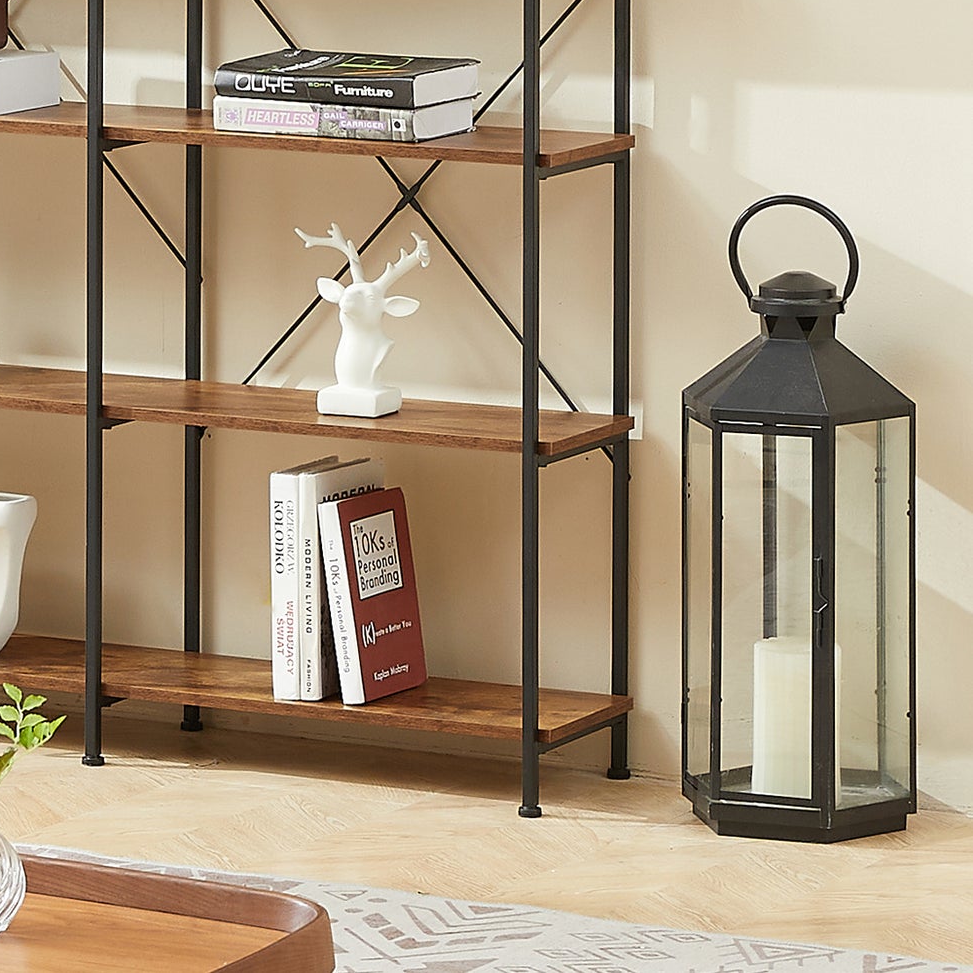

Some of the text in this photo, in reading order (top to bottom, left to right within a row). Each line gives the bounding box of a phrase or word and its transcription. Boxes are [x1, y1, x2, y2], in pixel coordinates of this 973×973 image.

[334, 84, 394, 98] Furniture
[247, 110, 316, 126] HEARTLESS
[323, 112, 345, 120] GAIL
[340, 121, 384, 129] CARRIGER
[353, 524, 364, 534] The
[354, 530, 386, 559] 10Ks
[329, 558, 341, 586] 10Ks
[358, 554, 398, 574] Personal
[304, 538, 313, 635] MODERN LIVING
[360, 569, 400, 592] Branding
[335, 594, 347, 633] Personal
[340, 636, 351, 674] Branding
